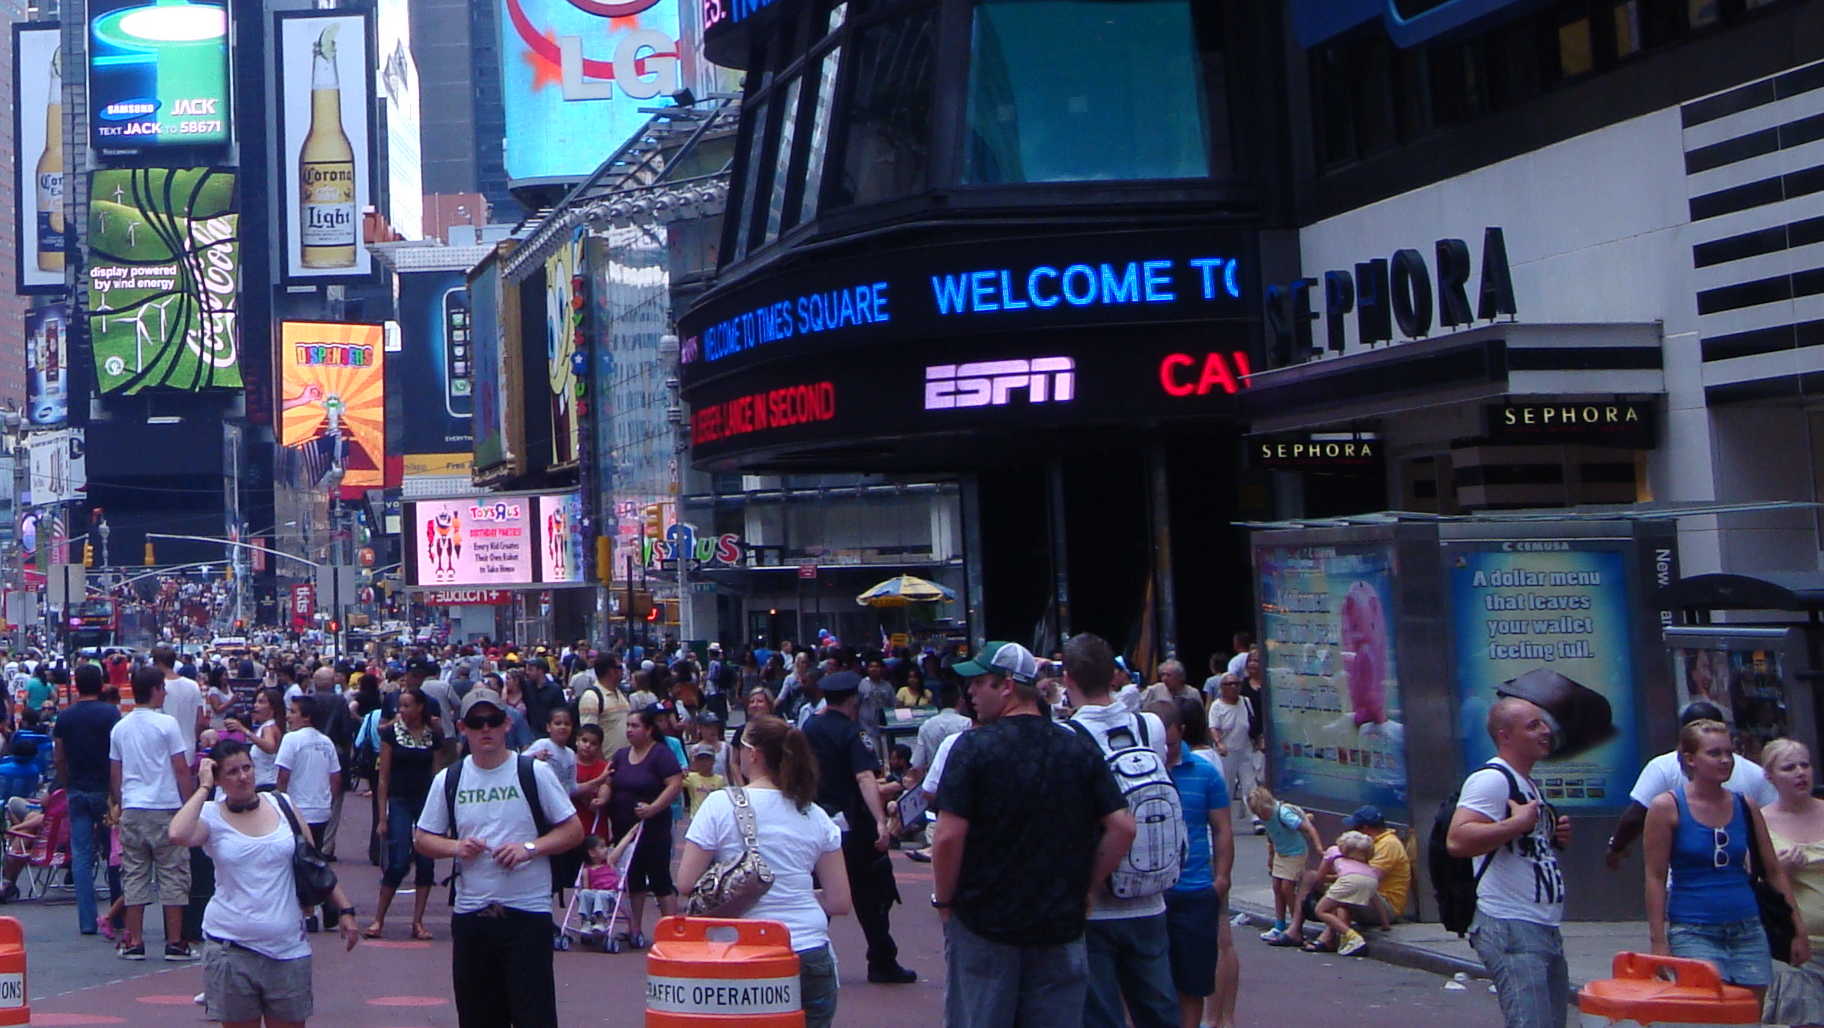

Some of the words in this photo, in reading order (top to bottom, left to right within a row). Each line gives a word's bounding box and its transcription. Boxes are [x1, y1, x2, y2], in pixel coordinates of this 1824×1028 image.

[561, 29, 679, 101] LG
[107, 103, 154, 115] SAMSUNG
[99, 126, 122, 136] TEXT
[124, 122, 161, 135] JACK
[165, 125, 177, 134] TO
[180, 121, 221, 134] 58671
[308, 207, 350, 228] Light
[90, 266, 128, 278] display
[131, 265, 177, 277] powered
[95, 279, 110, 292] by
[113, 278, 135, 289] wind
[138, 278, 175, 290] energy
[932, 260, 1174, 314] WELCOME
[1266, 226, 1517, 365] SEPHORA
[742, 312, 754, 349] TO
[757, 300, 793, 344] TIMES
[798, 282, 889, 334] SQUARE
[925, 357, 1075, 410] ESPN
[769, 381, 835, 428] SECOND
[1505, 406, 1639, 425] SEPHORA
[1262, 444, 1372, 459] SEPHORA
[1517, 541, 1570, 551] CEMUSA
[1472, 571, 1487, 587] A
[1491, 569, 1545, 587] dollar
[1550, 571, 1601, 586] menu
[297, 587, 310, 613] tkts
[1485, 594, 1526, 611] that
[1528, 593, 1591, 610] leaves
[1487, 620, 1529, 637] your
[1532, 616, 1594, 634] wallet
[1489, 642, 1554, 661] feeling
[1558, 640, 1594, 659] full.
[458, 785, 520, 804] STRAYA
[692, 985, 791, 1006] OPERATIONS
